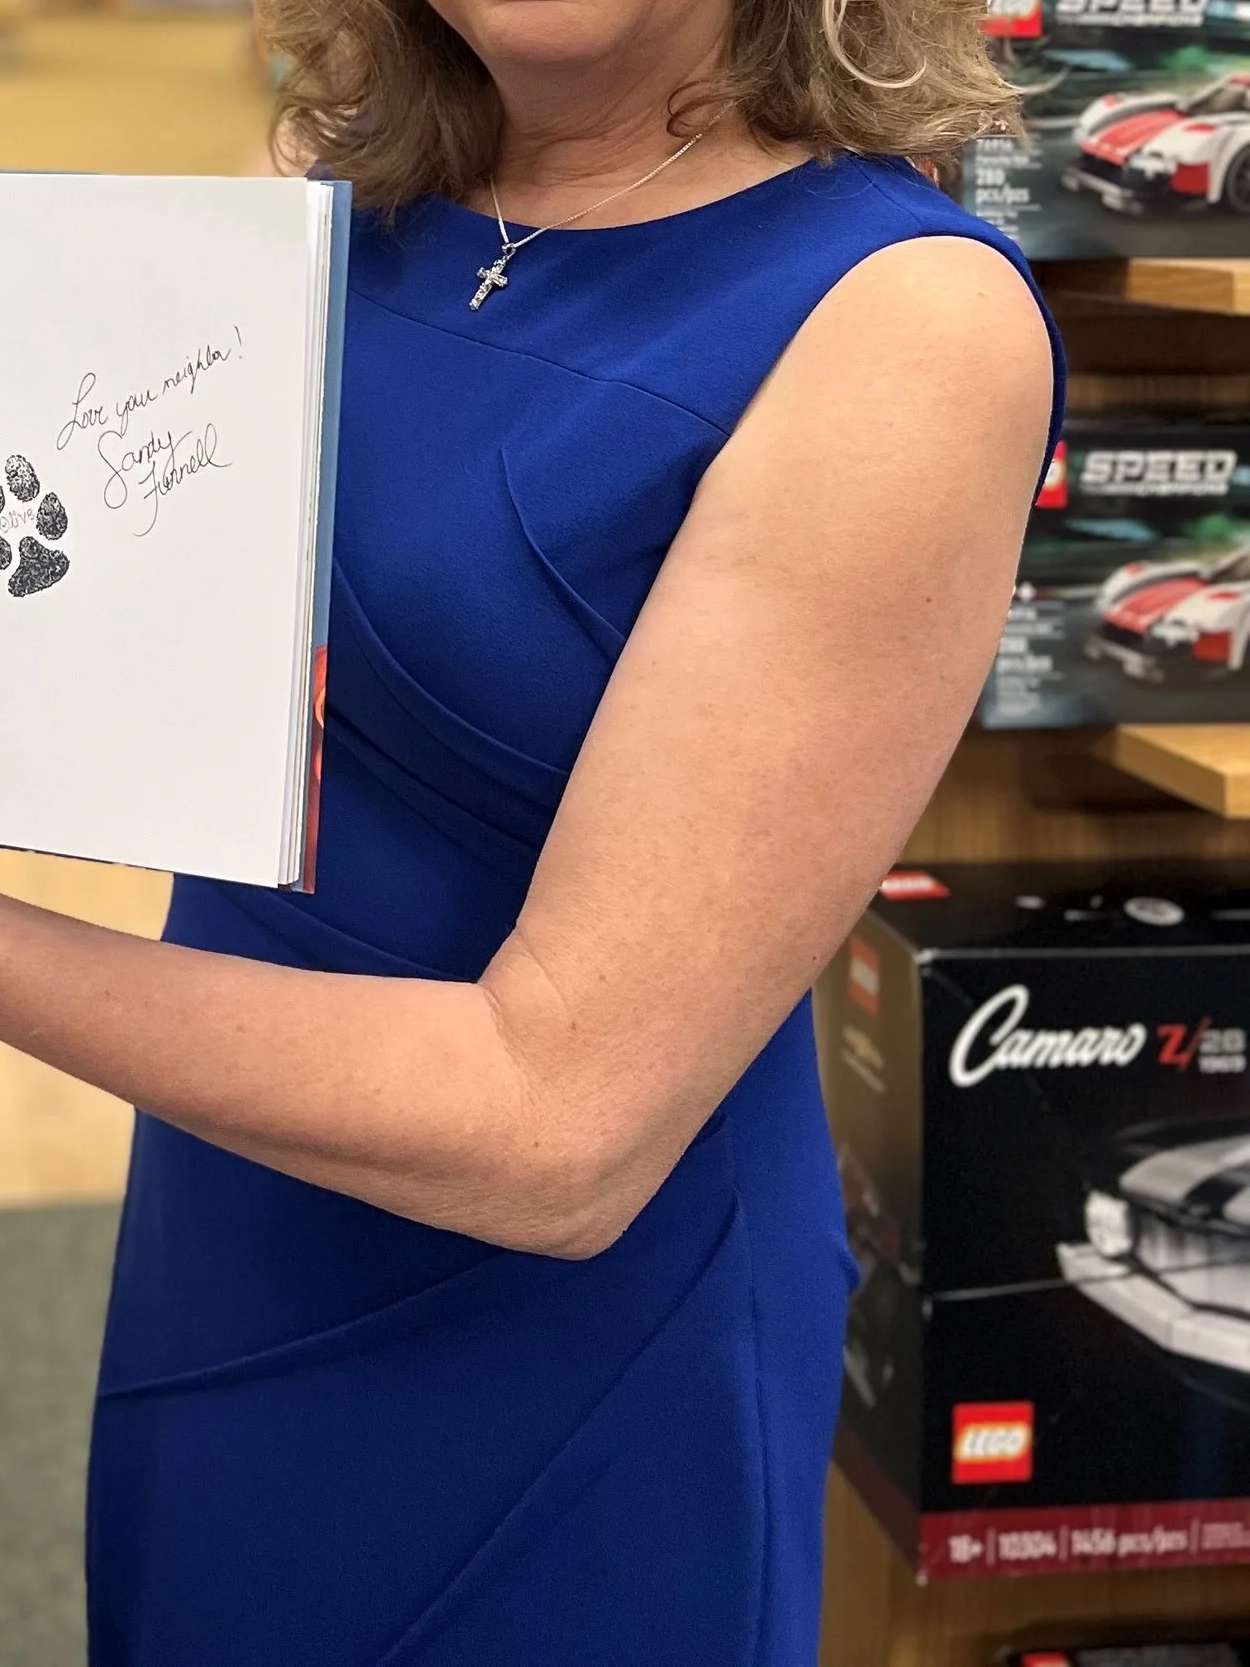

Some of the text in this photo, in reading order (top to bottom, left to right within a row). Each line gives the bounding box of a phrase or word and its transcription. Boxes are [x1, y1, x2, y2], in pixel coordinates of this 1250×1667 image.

[56, 372, 108, 450] Love
[98, 430, 192, 509] Sandy
[1080, 450, 1237, 484] SPEED
[0, 508, 35, 533] Olive
[949, 984, 1146, 1087] Camaro
[956, 1425, 1029, 1460] LEGO
